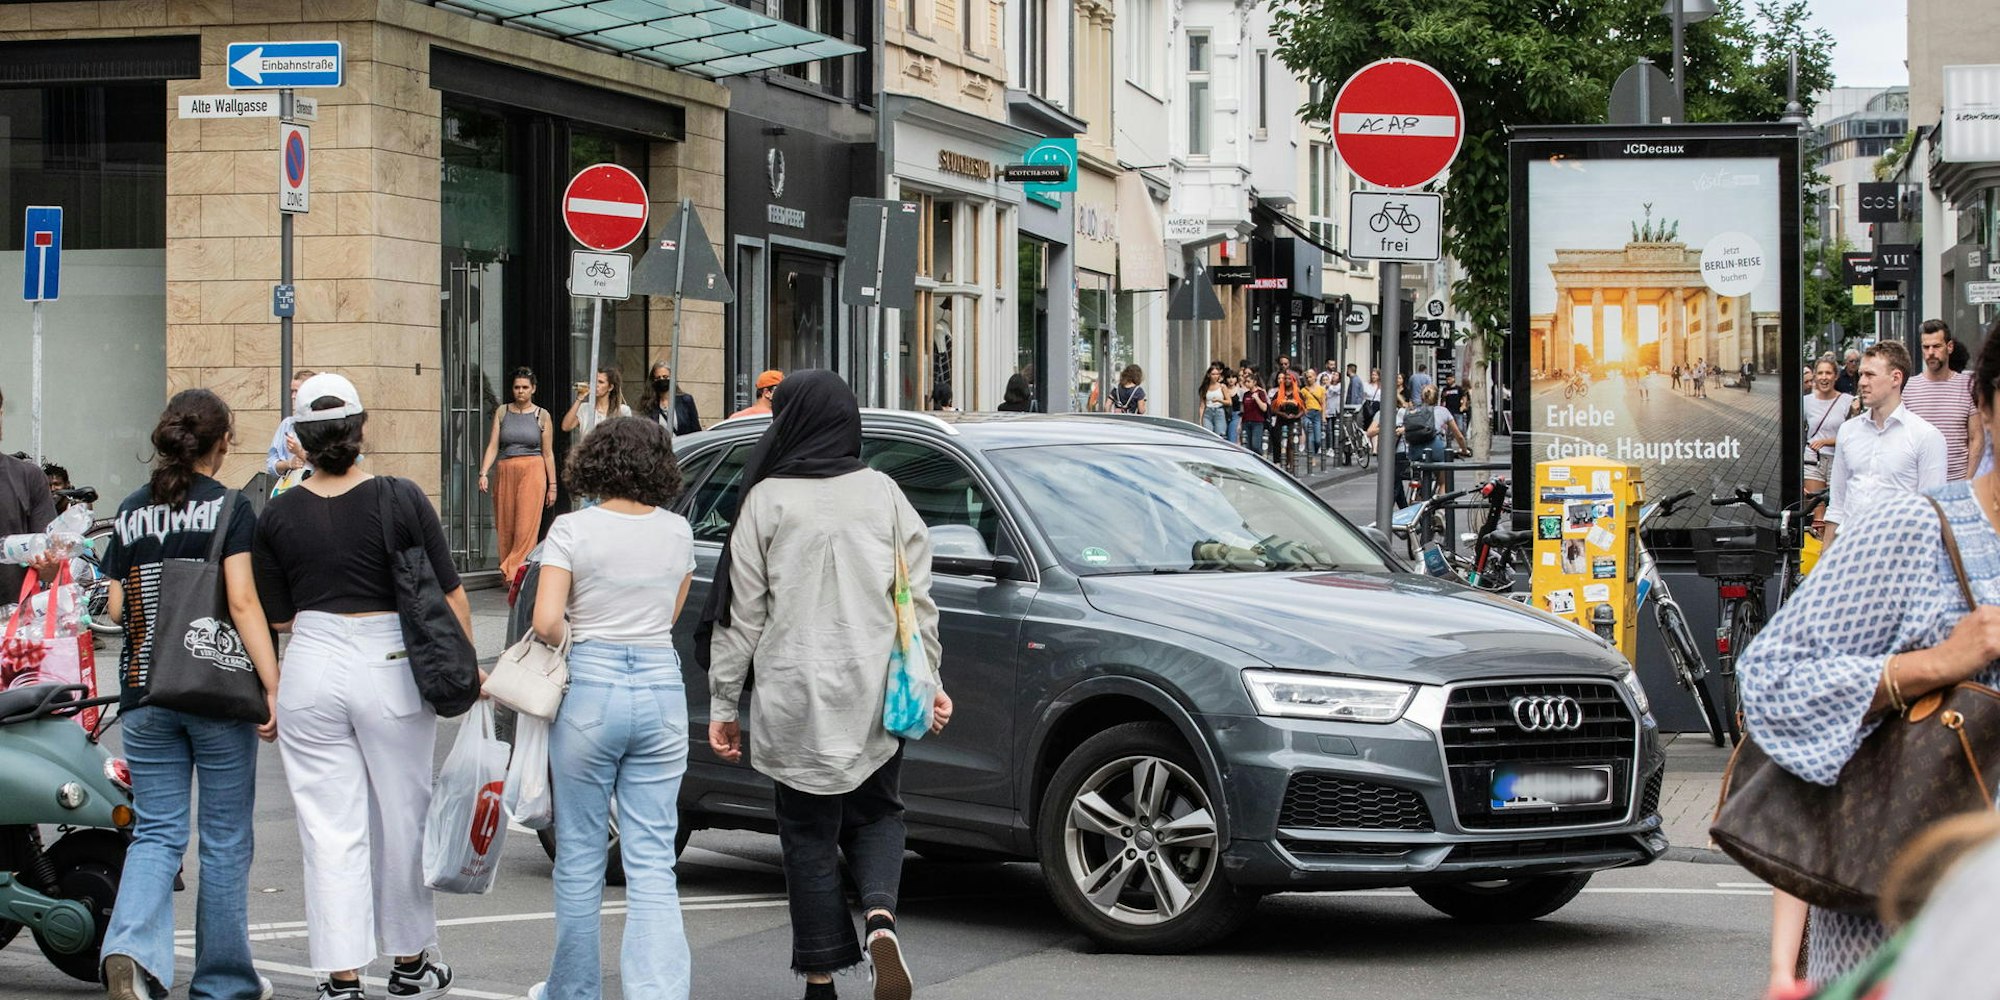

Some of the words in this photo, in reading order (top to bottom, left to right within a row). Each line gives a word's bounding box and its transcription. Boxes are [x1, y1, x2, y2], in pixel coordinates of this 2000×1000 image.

[262, 59, 334, 71] Einbahnstraße
[191, 100, 211, 113] Alte
[215, 99, 268, 115] Wallgasse
[1623, 143, 1685, 154] JCDecaux
[1008, 169, 1060, 177] SCOTCH&SODA
[287, 191, 303, 207] ZONE
[1861, 196, 1896, 209] COS
[1381, 237, 1409, 252] frei
[1723, 246, 1740, 256] Jetzt
[1704, 256, 1762, 271] BERLIN-REISE
[1883, 254, 1910, 265] VIU
[594, 279, 606, 287] frei
[1720, 273, 1748, 283] buchen
[1546, 403, 1615, 427] Erlebe
[1547, 437, 1608, 460] deine
[1616, 435, 1741, 465] Hauptstadt
